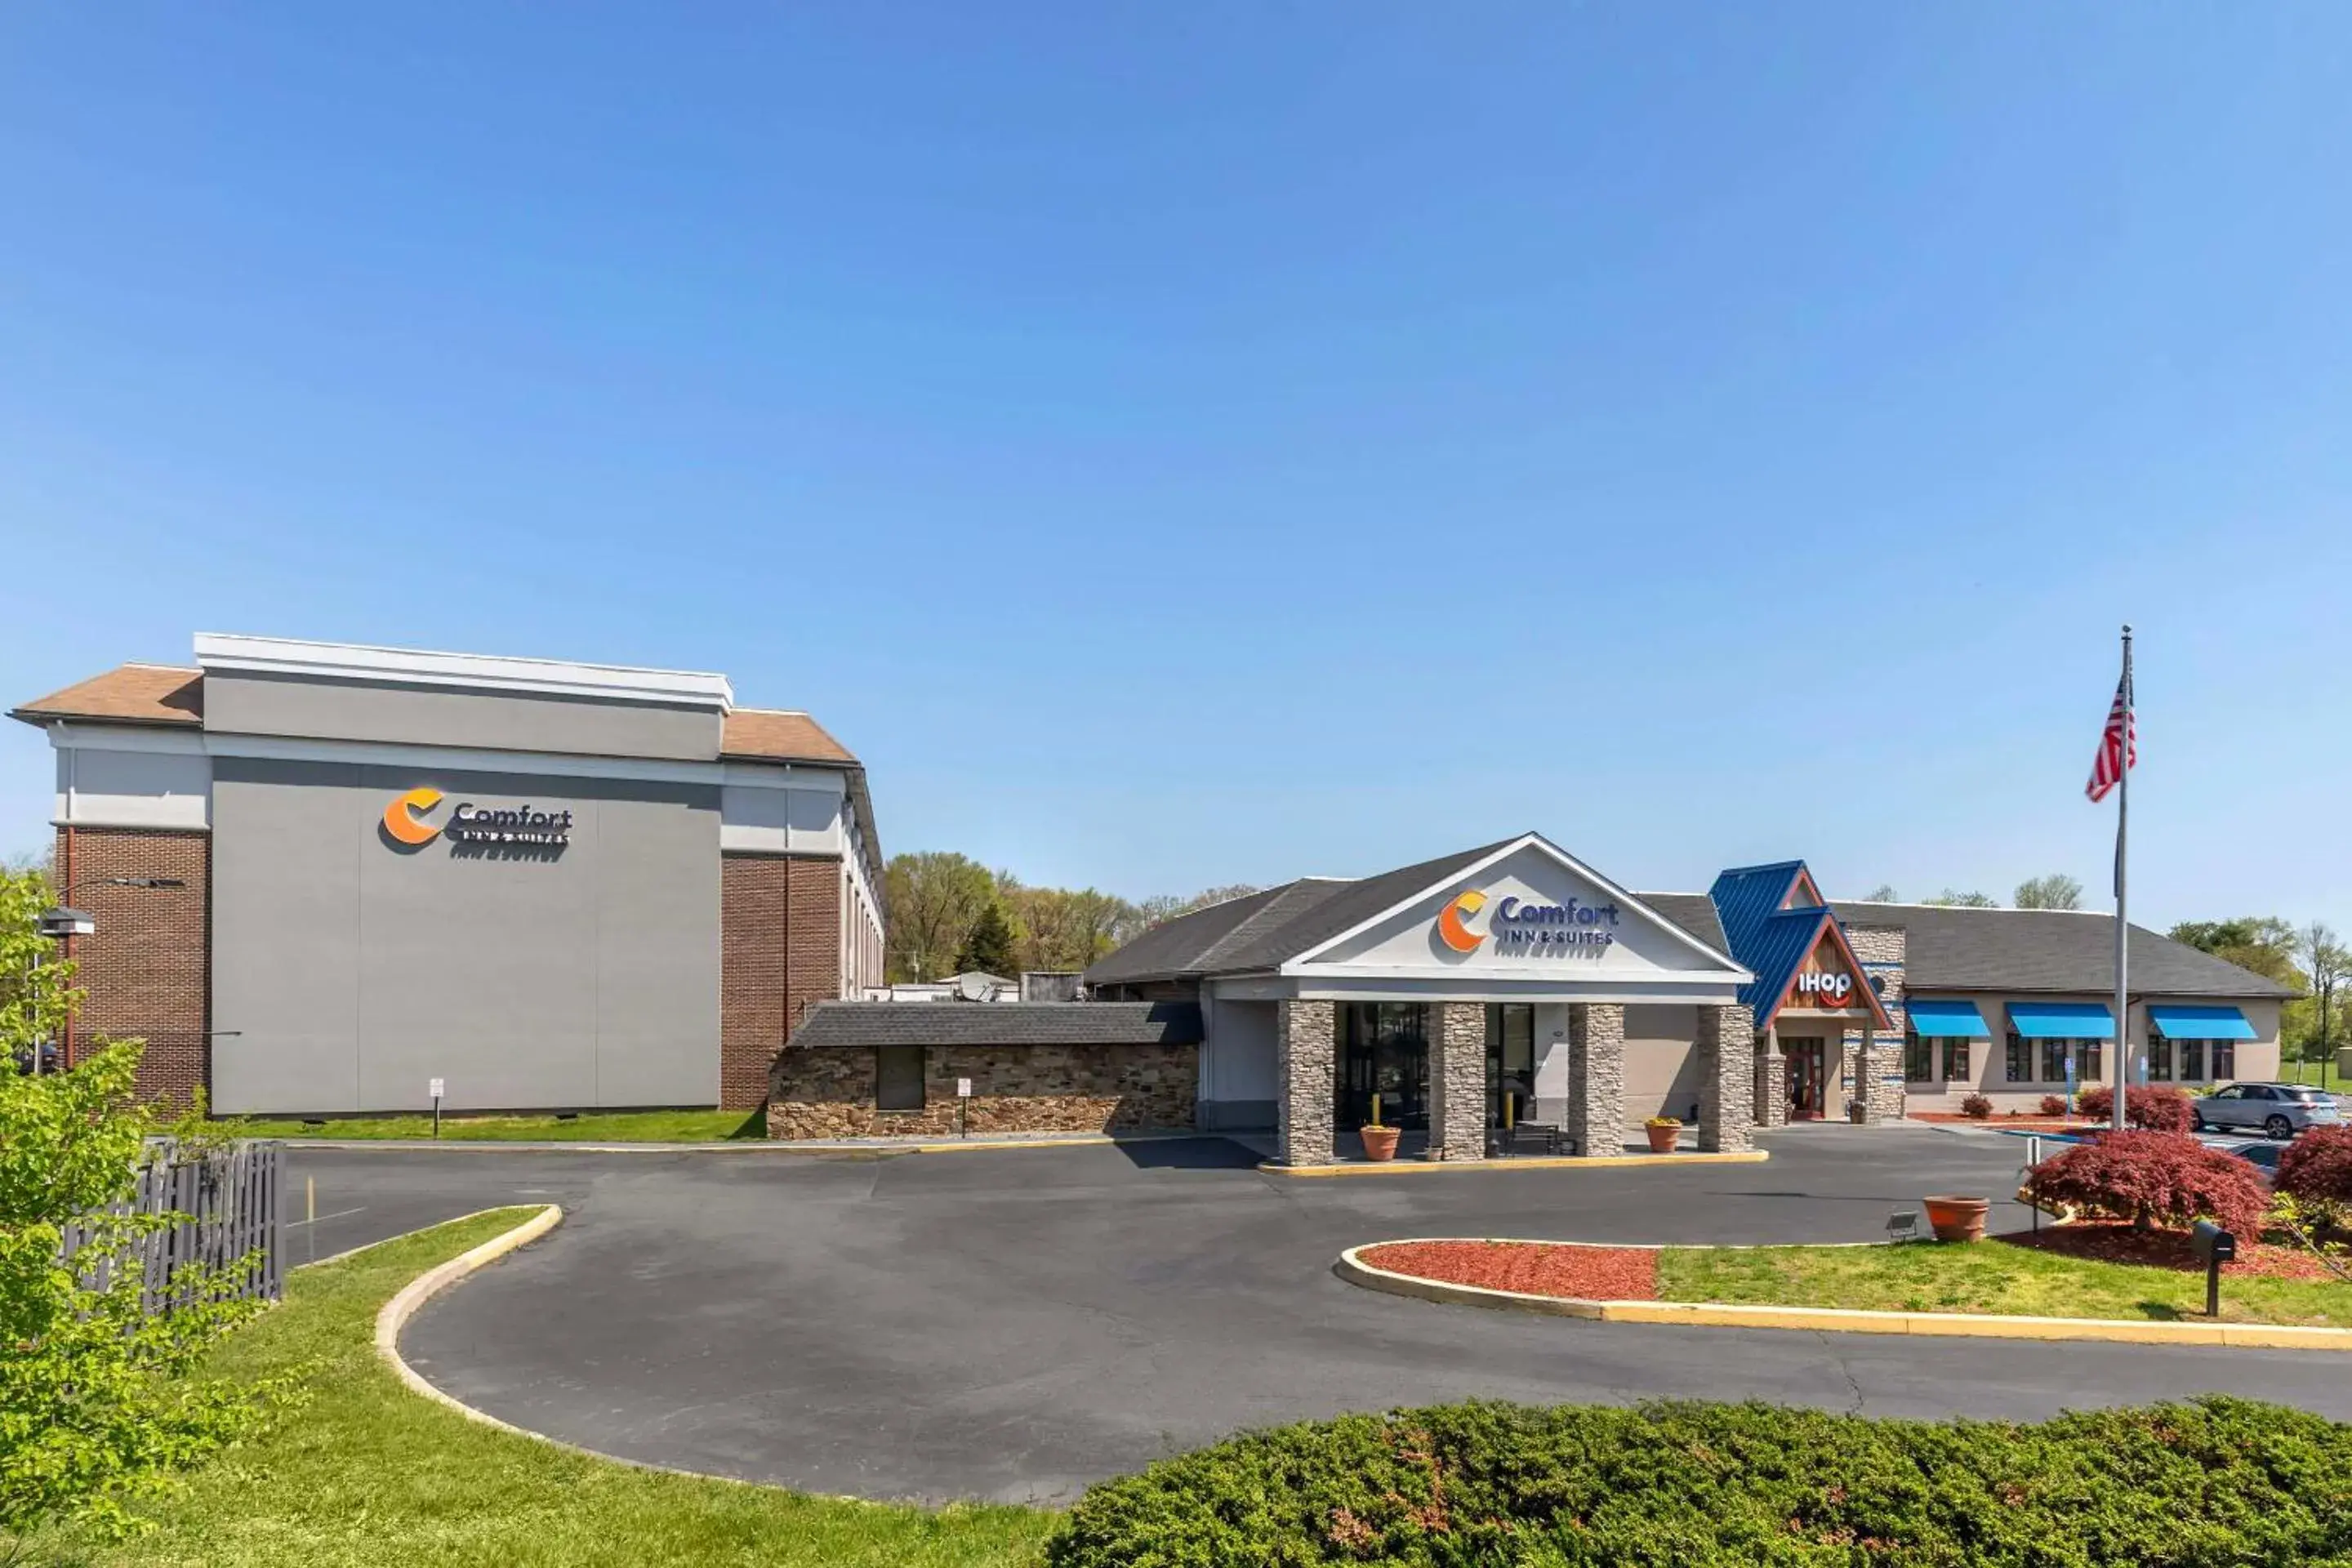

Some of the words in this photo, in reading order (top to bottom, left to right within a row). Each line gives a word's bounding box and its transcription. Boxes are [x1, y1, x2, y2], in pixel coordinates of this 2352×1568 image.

[454, 802, 572, 828] Comfort
[1499, 896, 1619, 924] Comfort
[1503, 929, 1535, 943] INN
[1541, 931, 1550, 943] &
[1557, 931, 1613, 945] SUITES
